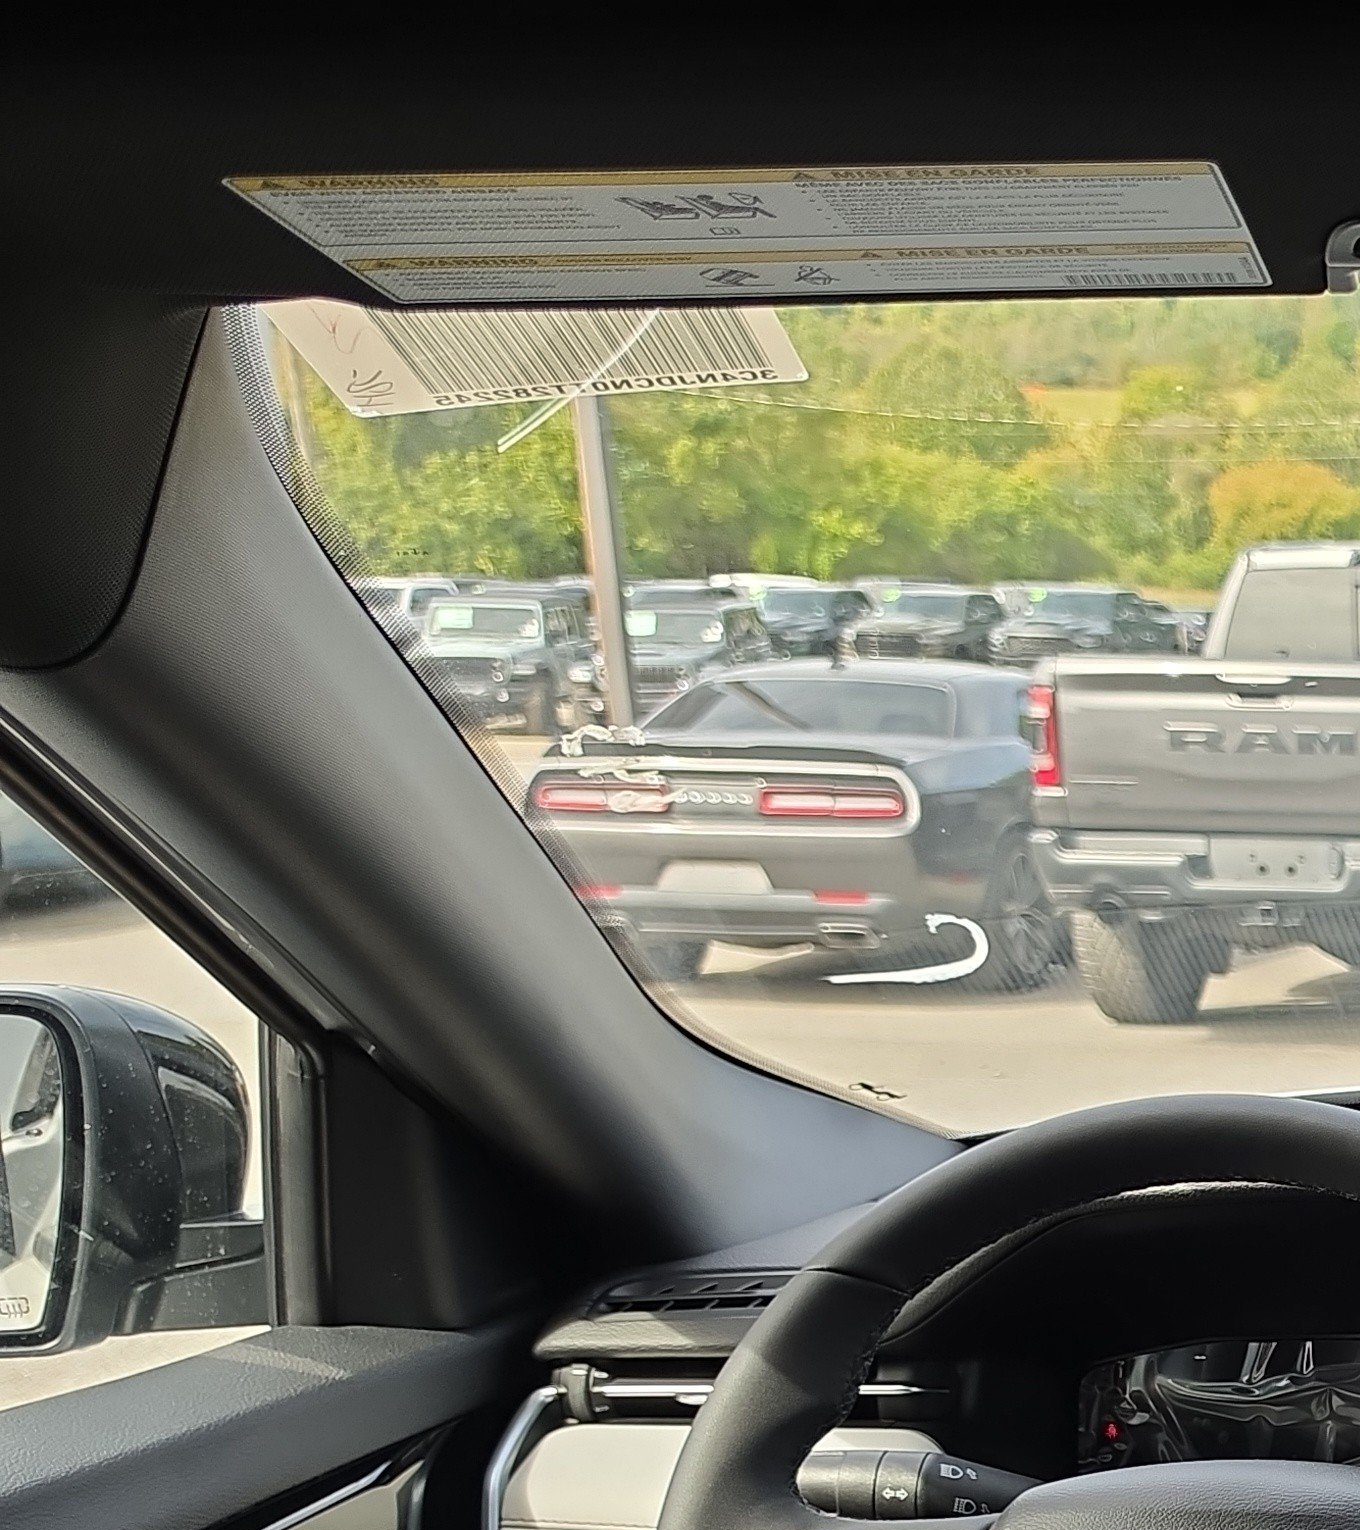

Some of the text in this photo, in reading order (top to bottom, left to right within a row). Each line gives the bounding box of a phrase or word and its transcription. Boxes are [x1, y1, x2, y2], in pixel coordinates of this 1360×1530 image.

[831, 170, 899, 179] MISE
[906, 169, 942, 178] EN
[1163, 721, 1359, 755] RAM
